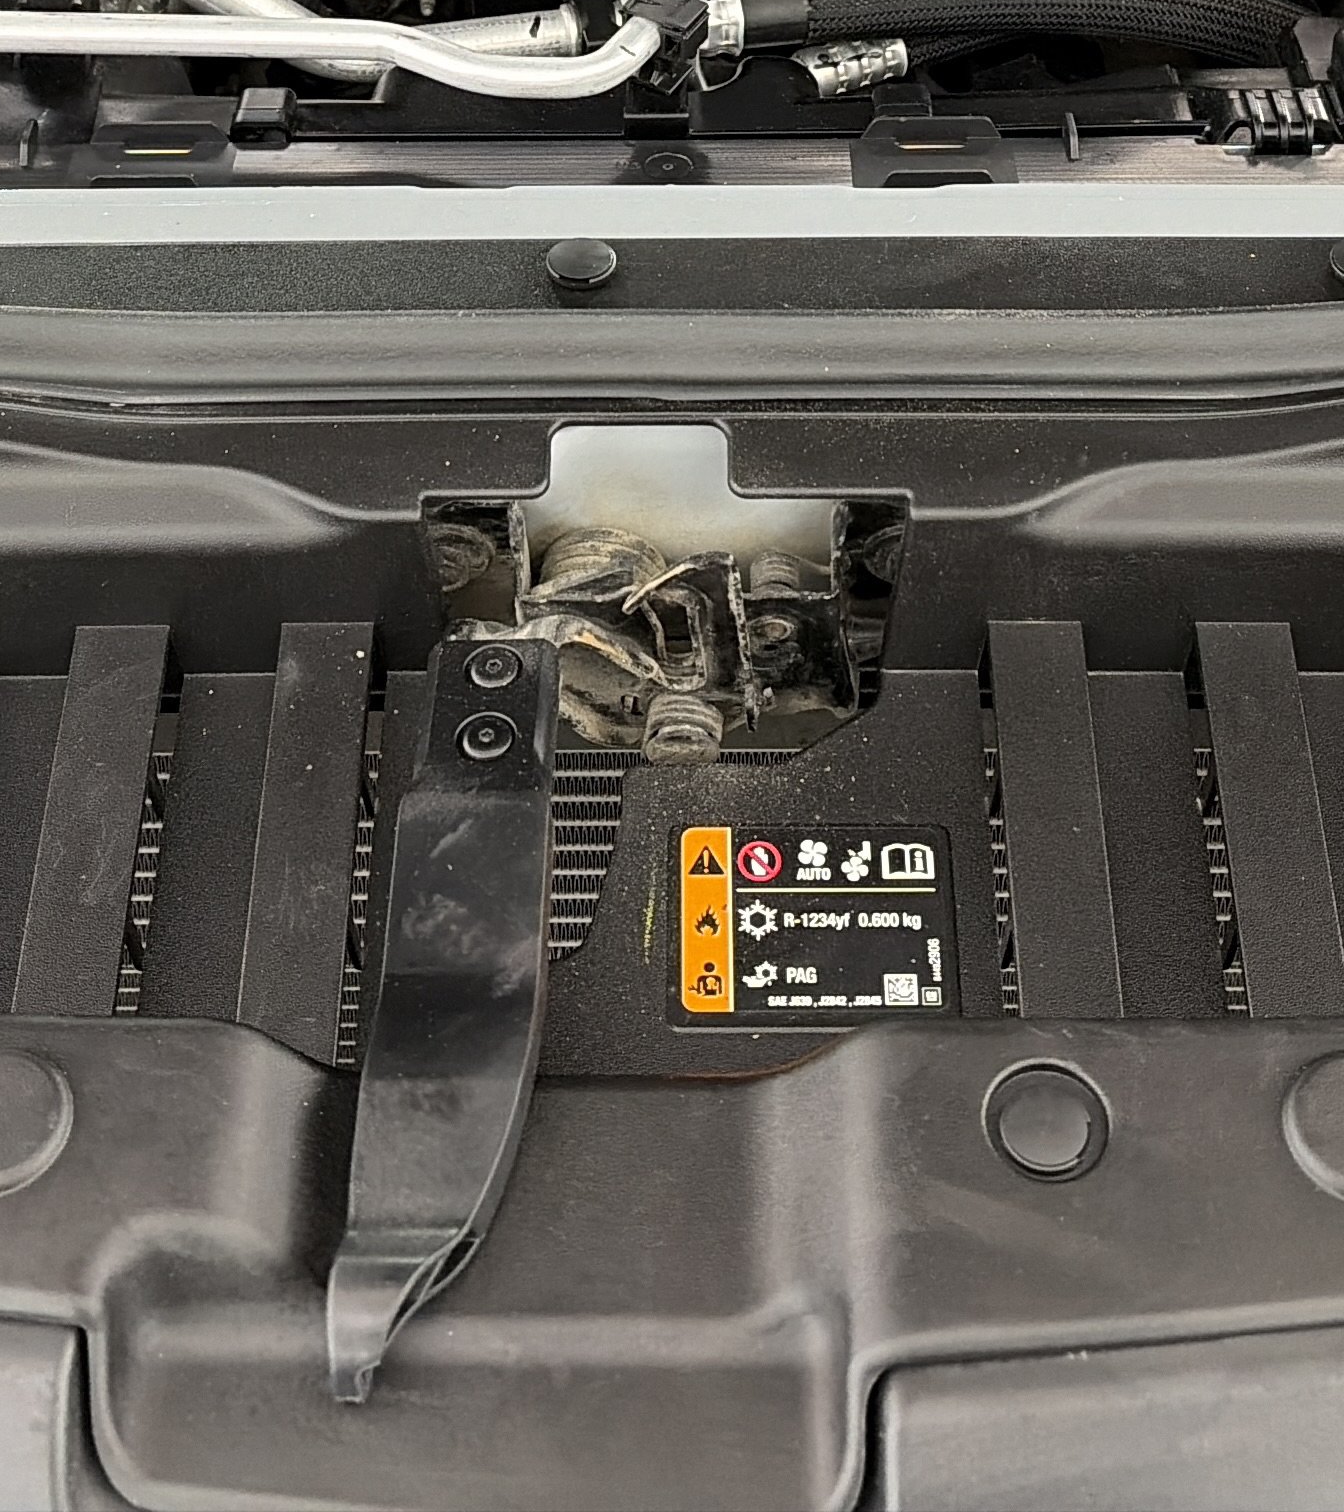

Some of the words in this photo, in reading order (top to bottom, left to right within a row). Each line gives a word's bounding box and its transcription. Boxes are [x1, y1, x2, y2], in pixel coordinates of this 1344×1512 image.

[796, 867, 831, 881] AUTO
[783, 912, 851, 931] R-1234yf
[857, 912, 900, 928] 0.600
[902, 912, 923, 931] kg
[786, 967, 818, 984] PAG
